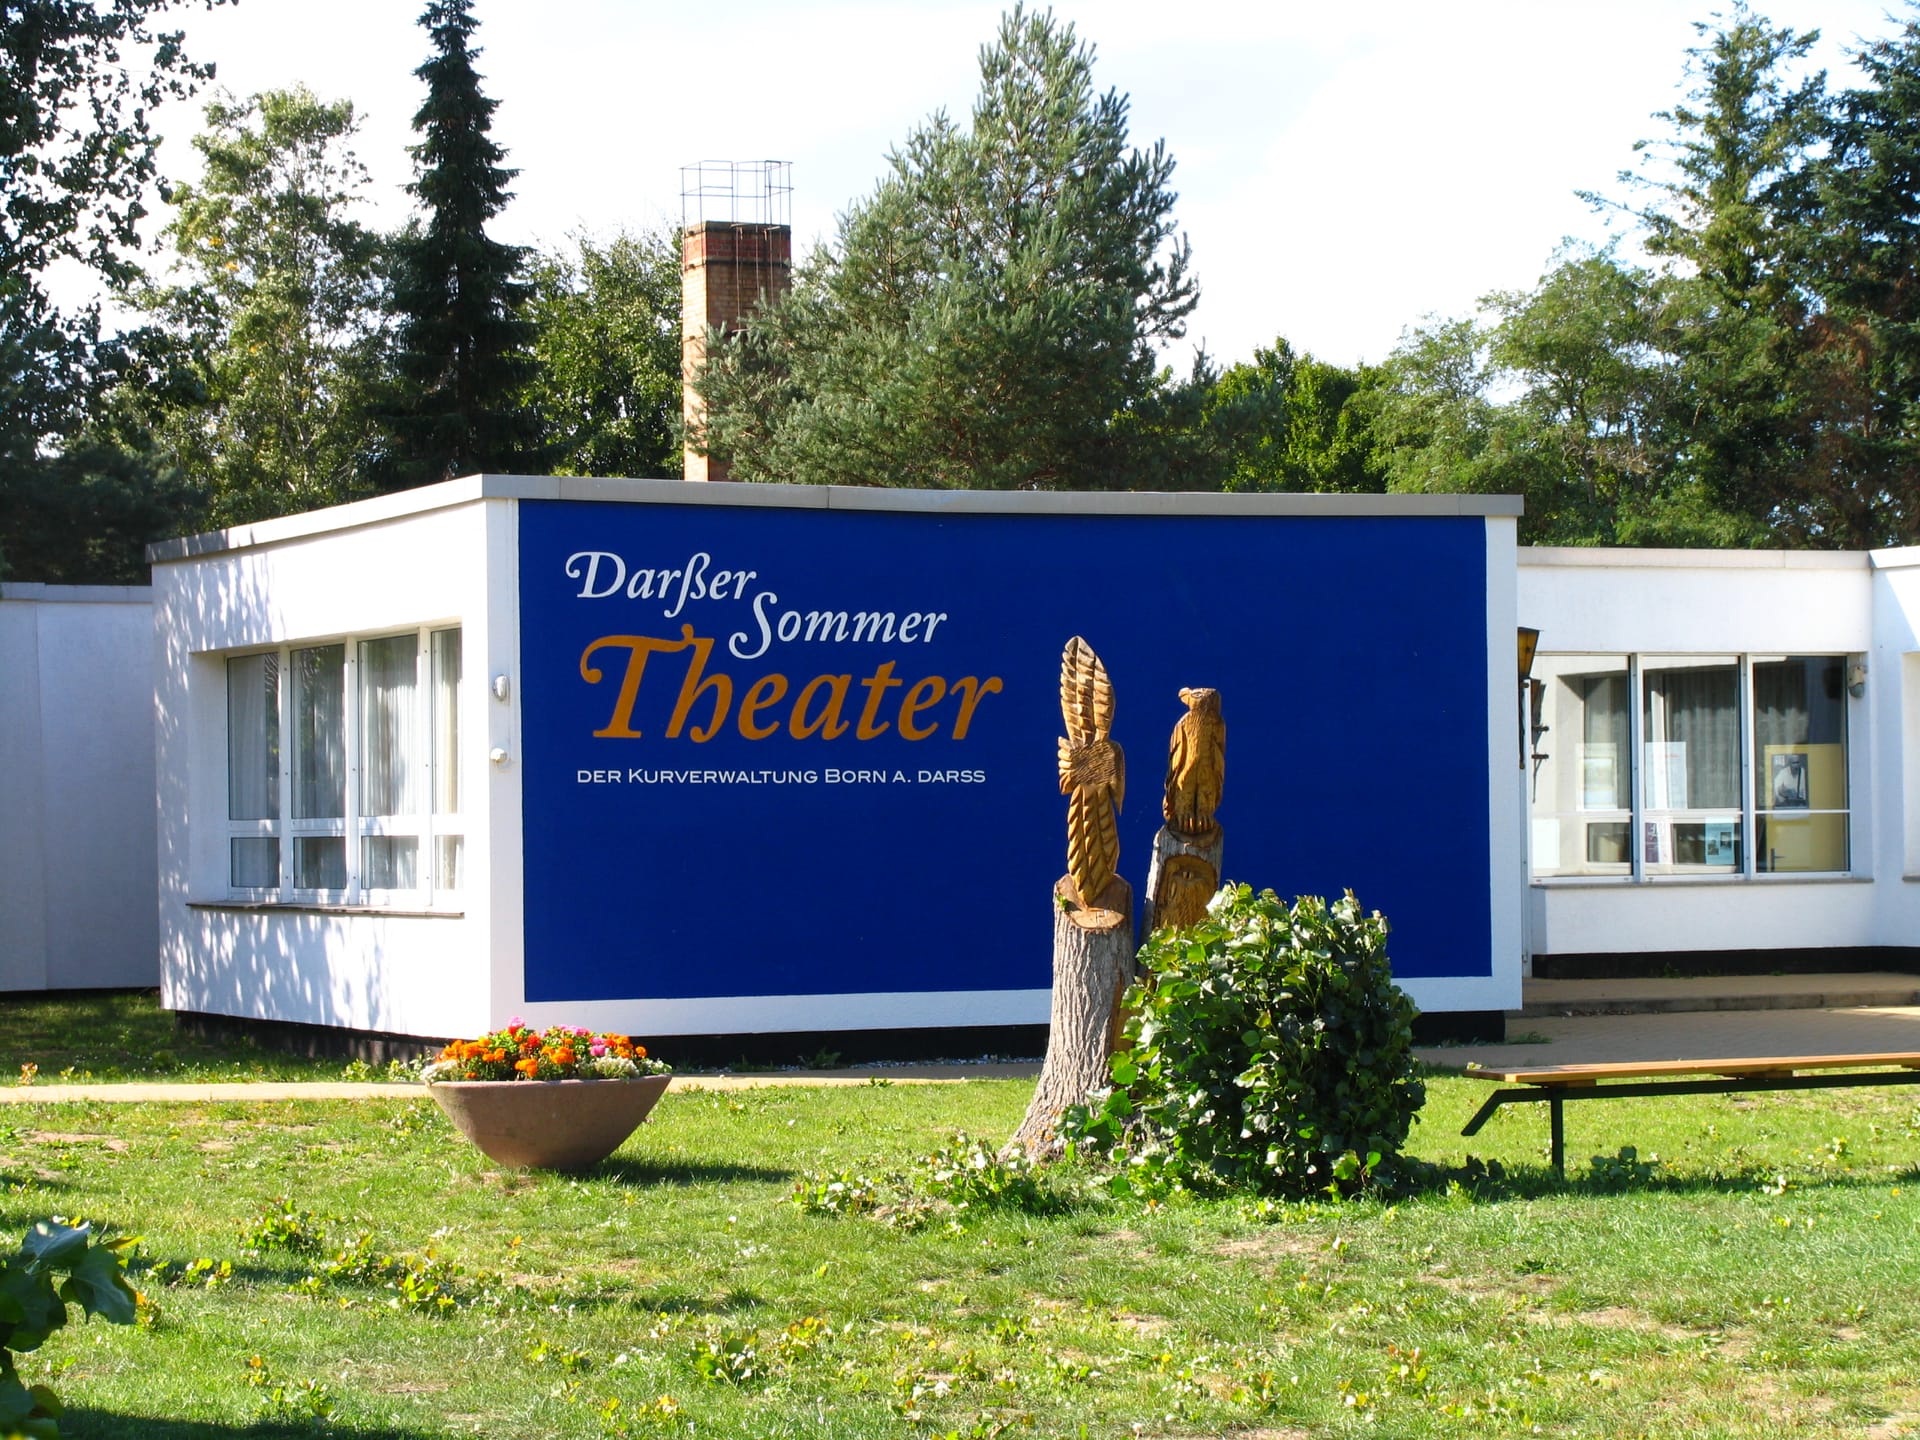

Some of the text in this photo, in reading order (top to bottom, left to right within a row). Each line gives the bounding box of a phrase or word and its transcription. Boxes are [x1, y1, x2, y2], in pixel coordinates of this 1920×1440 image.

[565, 551, 757, 618] Darßer
[729, 592, 948, 660] Sommer
[580, 624, 1004, 743] Theater
[577, 768, 986, 785] DER KURVERWALTUNG BORN A. DARSS
